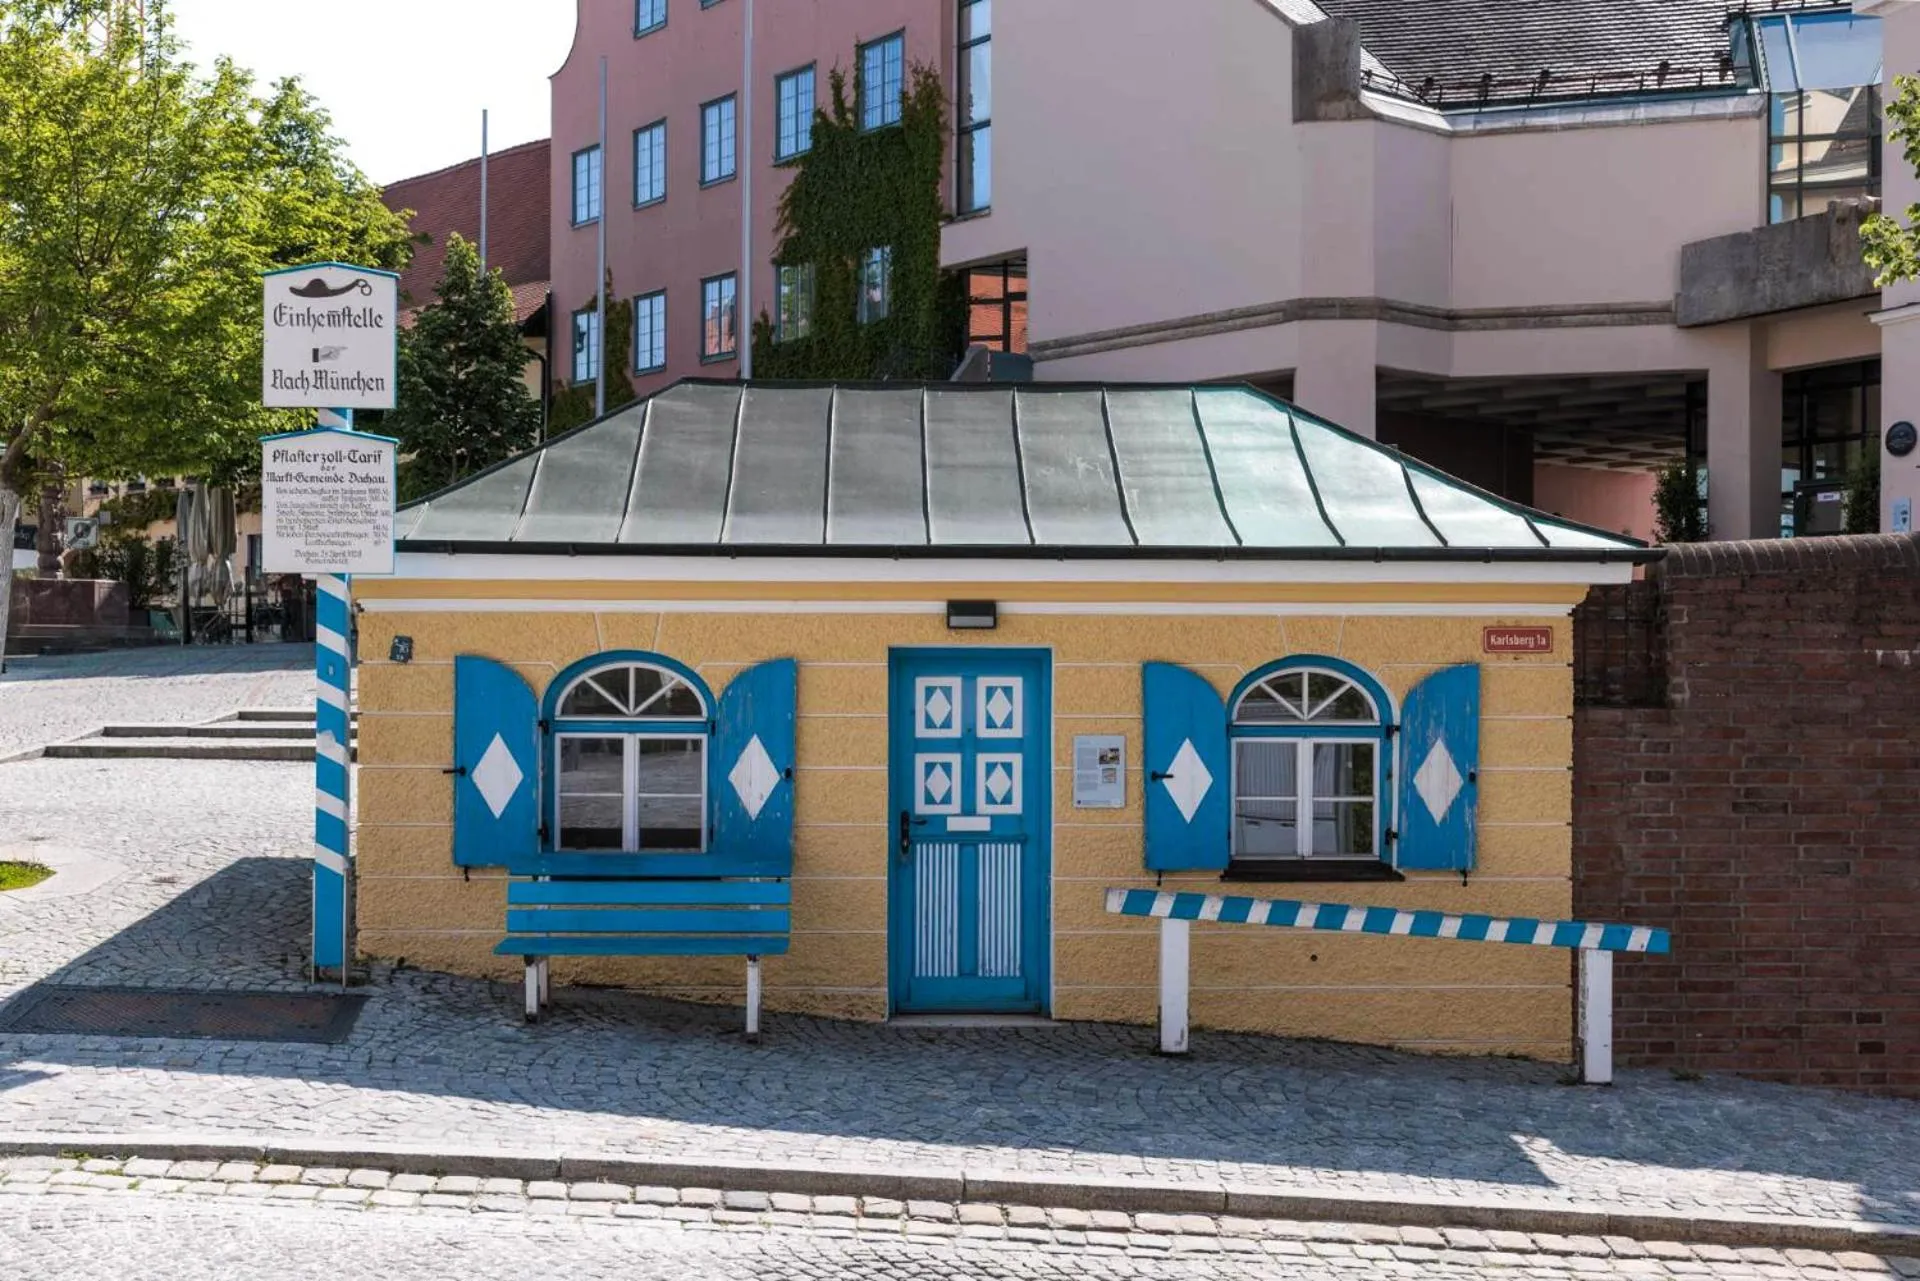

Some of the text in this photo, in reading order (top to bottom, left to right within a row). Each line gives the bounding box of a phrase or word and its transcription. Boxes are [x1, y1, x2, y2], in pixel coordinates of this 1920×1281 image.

[271, 369, 385, 397] Nach München
[1490, 634, 1534, 649] Karlsberg
